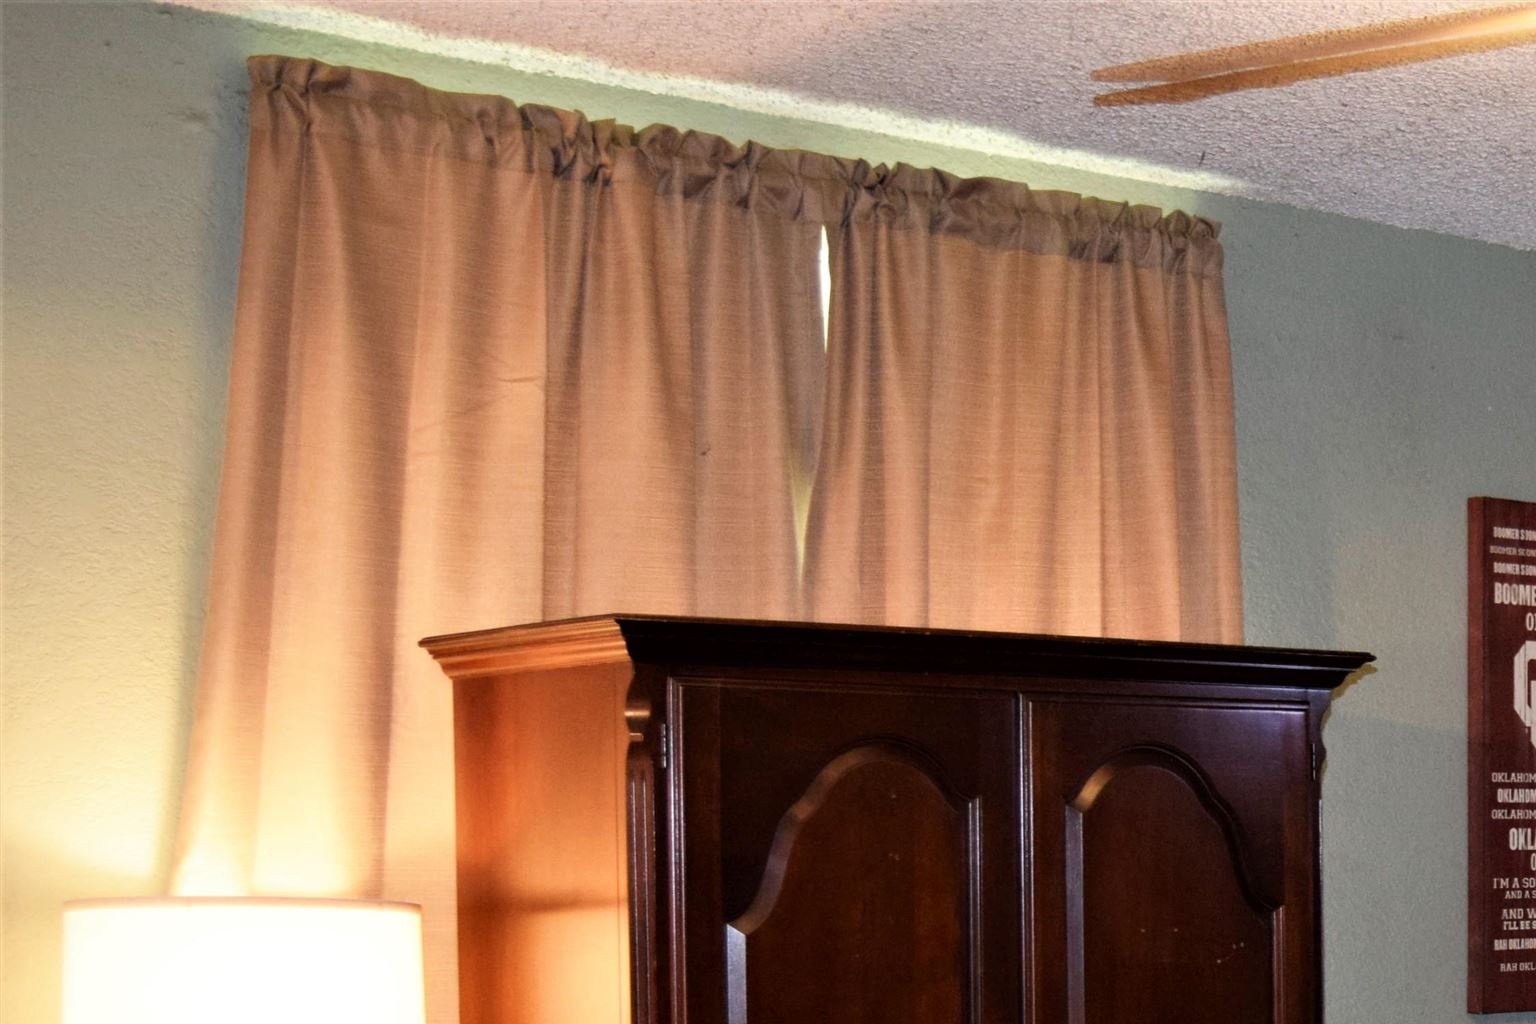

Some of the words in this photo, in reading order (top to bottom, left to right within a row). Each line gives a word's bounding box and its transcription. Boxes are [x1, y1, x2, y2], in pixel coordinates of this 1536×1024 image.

[1493, 526, 1519, 540] BOOMER
[1493, 562, 1520, 575] BOOMER
[1493, 877, 1509, 889] I'M
[1512, 877, 1520, 889] A
[1504, 890, 1522, 899] AND
[1524, 890, 1531, 899] A
[1501, 908, 1524, 920] AND
[1503, 921, 1519, 931] I'LL
[1521, 920, 1531, 930] BE
[1494, 938, 1508, 951] RAH
[1500, 962, 1517, 972] RAH
